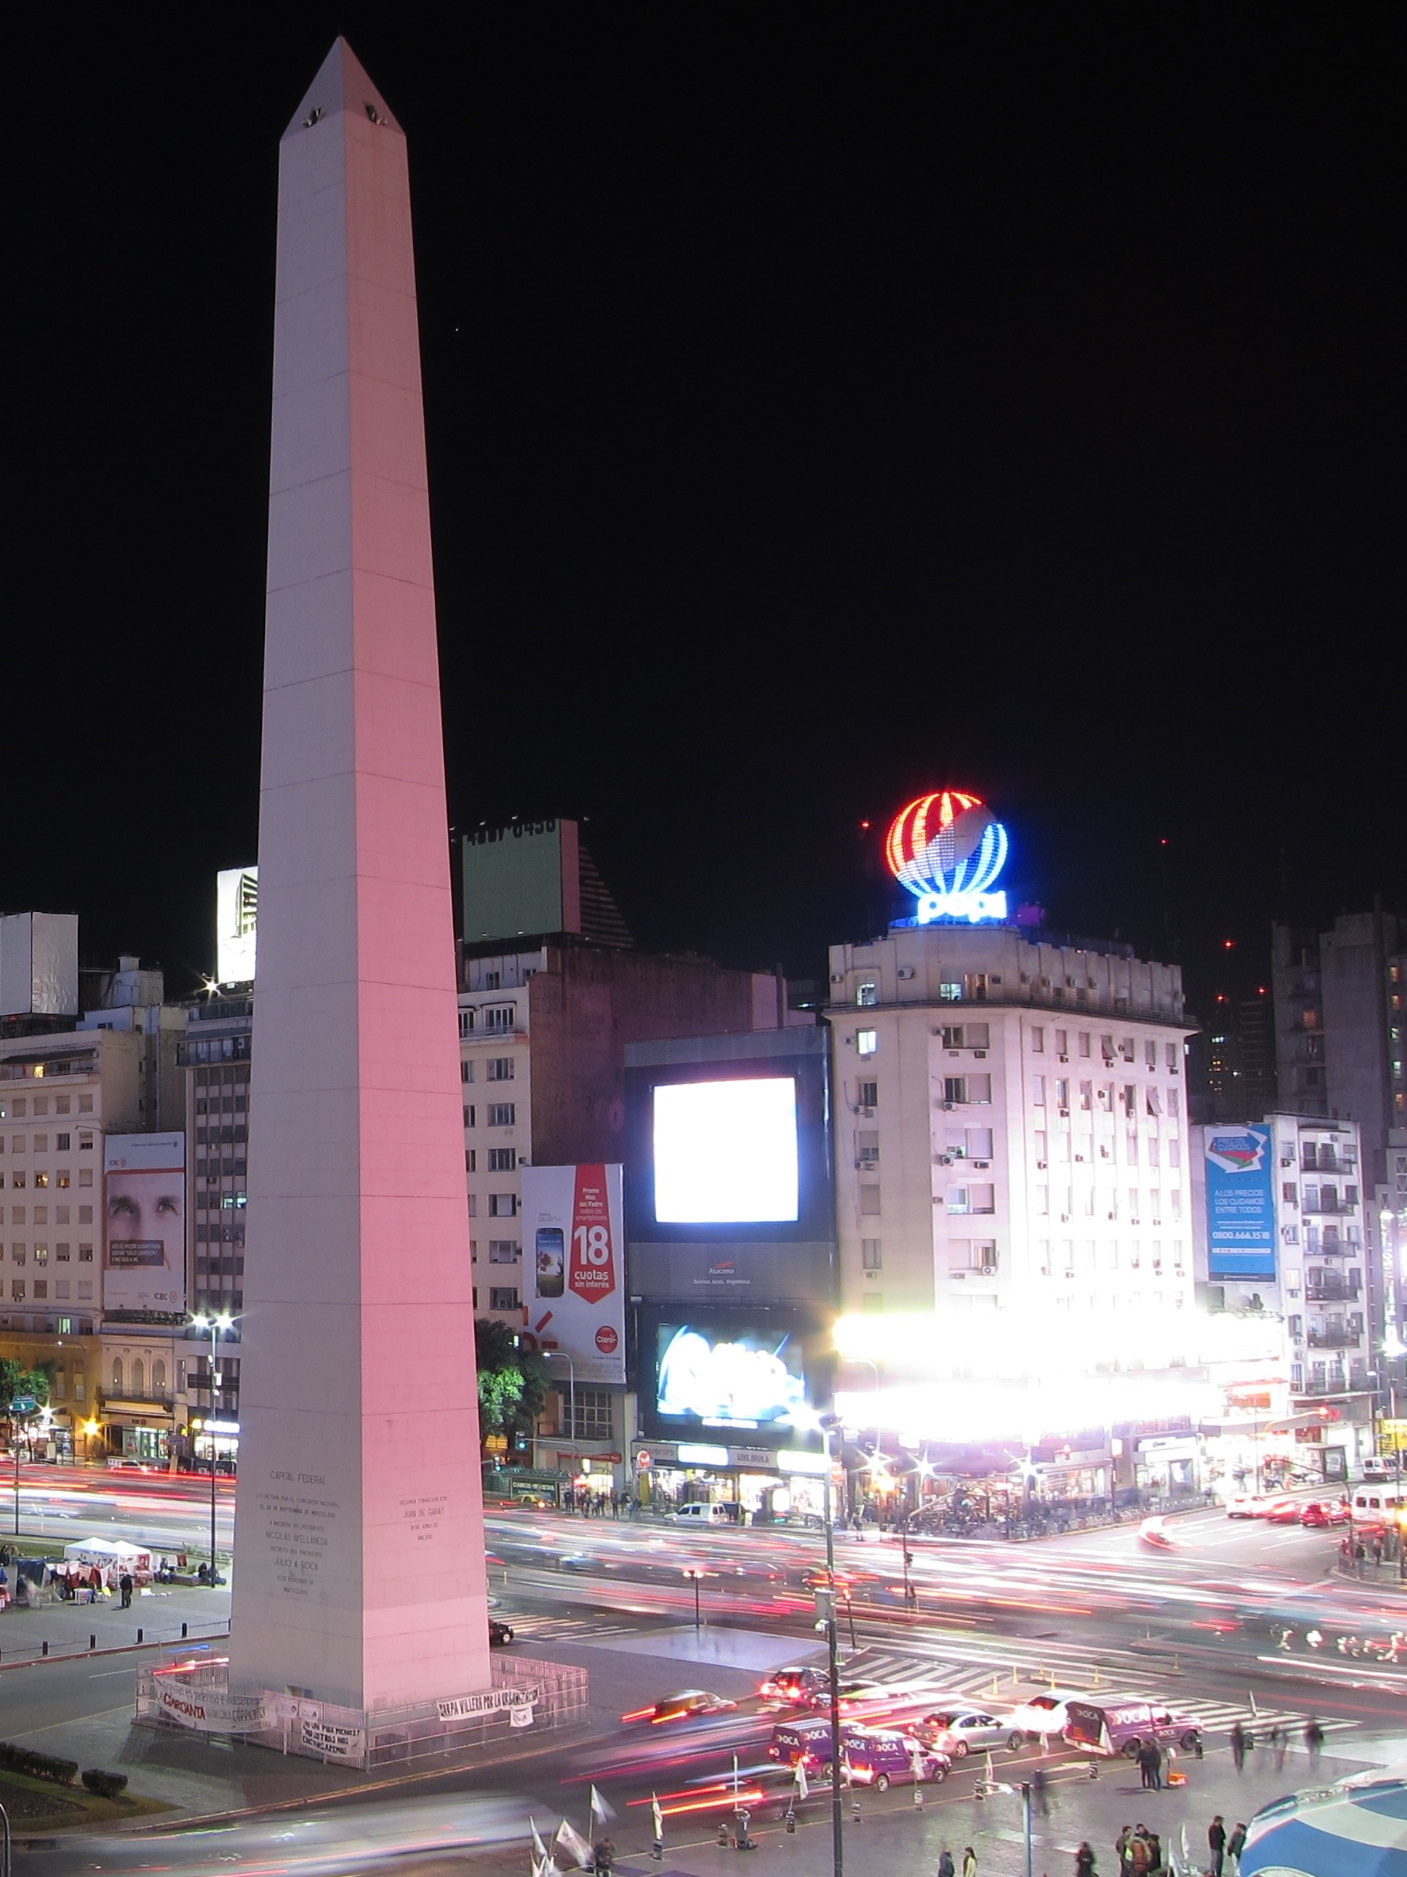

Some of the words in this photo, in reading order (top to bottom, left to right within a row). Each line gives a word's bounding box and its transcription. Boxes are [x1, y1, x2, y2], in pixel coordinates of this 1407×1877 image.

[574, 1225, 609, 1266] 18
[575, 1269, 609, 1280] cuotas
[154, 1292, 169, 1301] ICBC
[270, 1470, 294, 1481] CAPITAL
[298, 1473, 327, 1486] FEDERAL
[274, 1557, 292, 1567] JULIO
[301, 1560, 319, 1571] ROCA
[439, 1701, 459, 1717] CARPA
[459, 1696, 482, 1714] VILLERA
[483, 1694, 493, 1710] POR
[494, 1692, 501, 1707] LA
[1082, 1709, 1099, 1720] OCA
[1120, 1706, 1150, 1724] OCA
[809, 1729, 828, 1740] OCA
[782, 1735, 800, 1746] OCA
[848, 1739, 866, 1751] OCA
[881, 1743, 898, 1752] OCA
